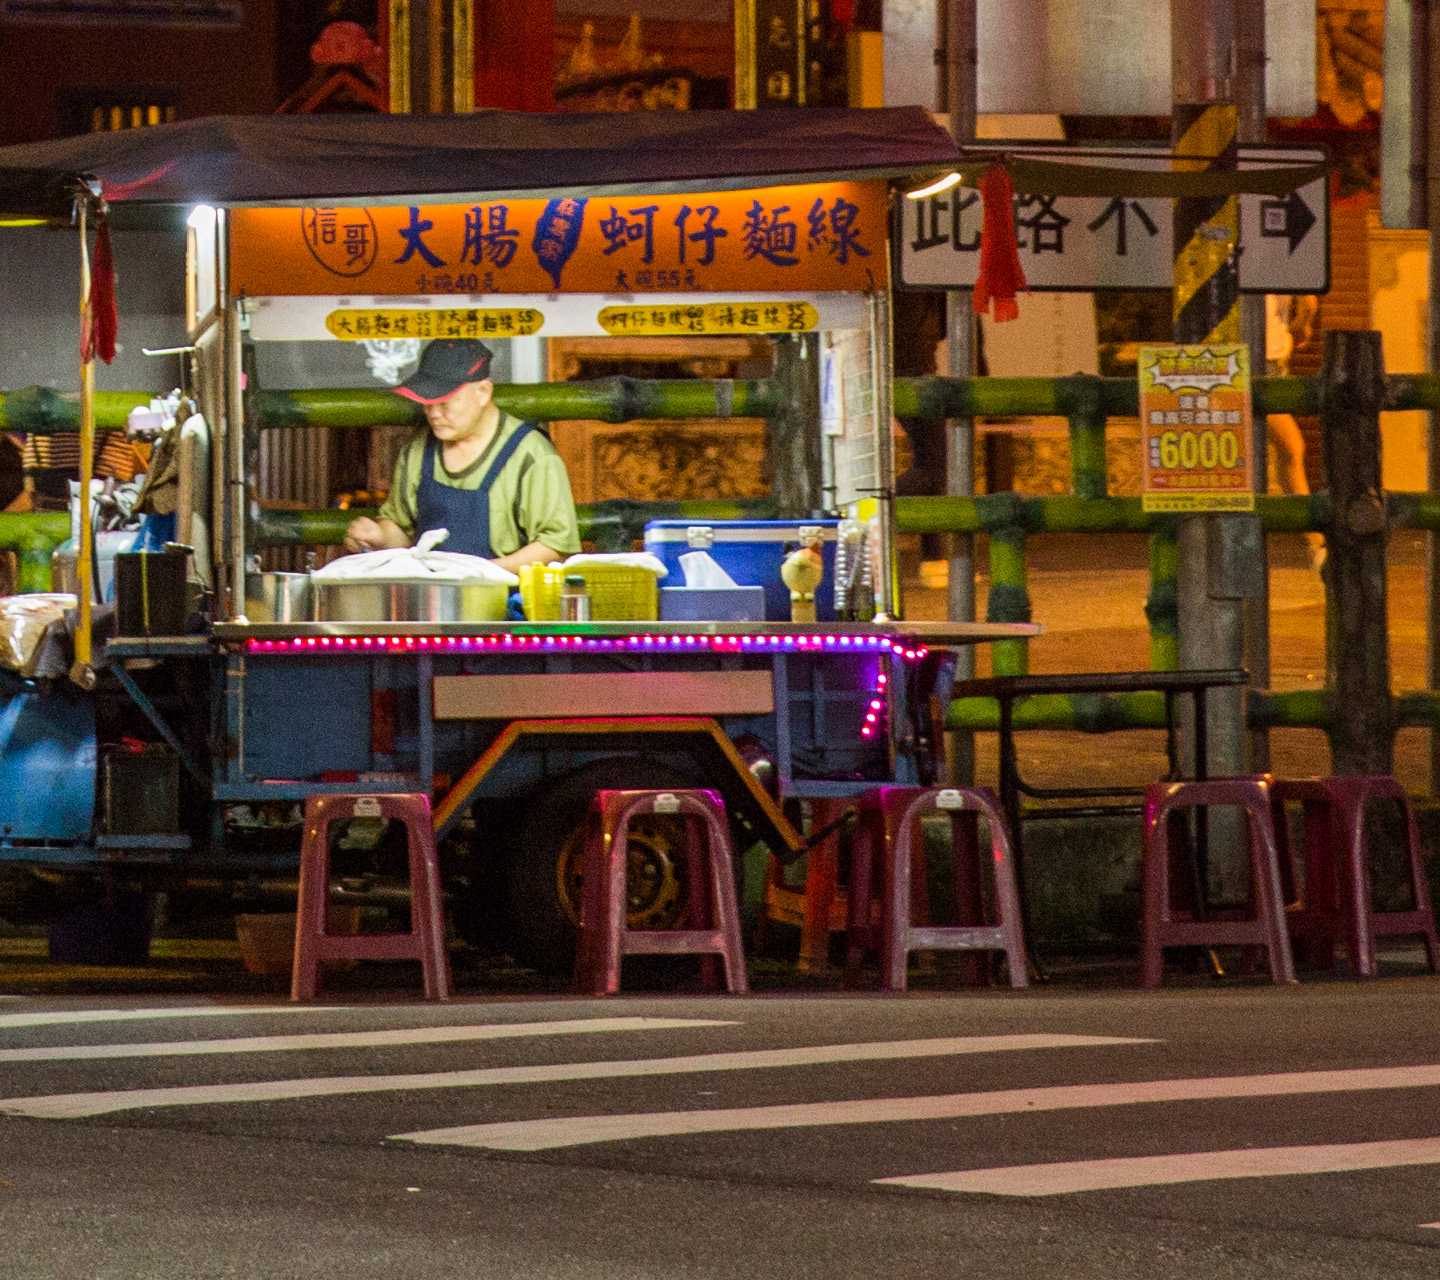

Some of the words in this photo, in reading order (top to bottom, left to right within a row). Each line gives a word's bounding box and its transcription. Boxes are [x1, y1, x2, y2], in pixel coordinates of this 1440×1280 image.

[308, 207, 370, 267] 信哥
[393, 205, 521, 269] 大腸
[599, 196, 872, 268] 蚵仔麵線
[910, 188, 1161, 258] 此路不
[1160, 430, 1239, 470] 6000
